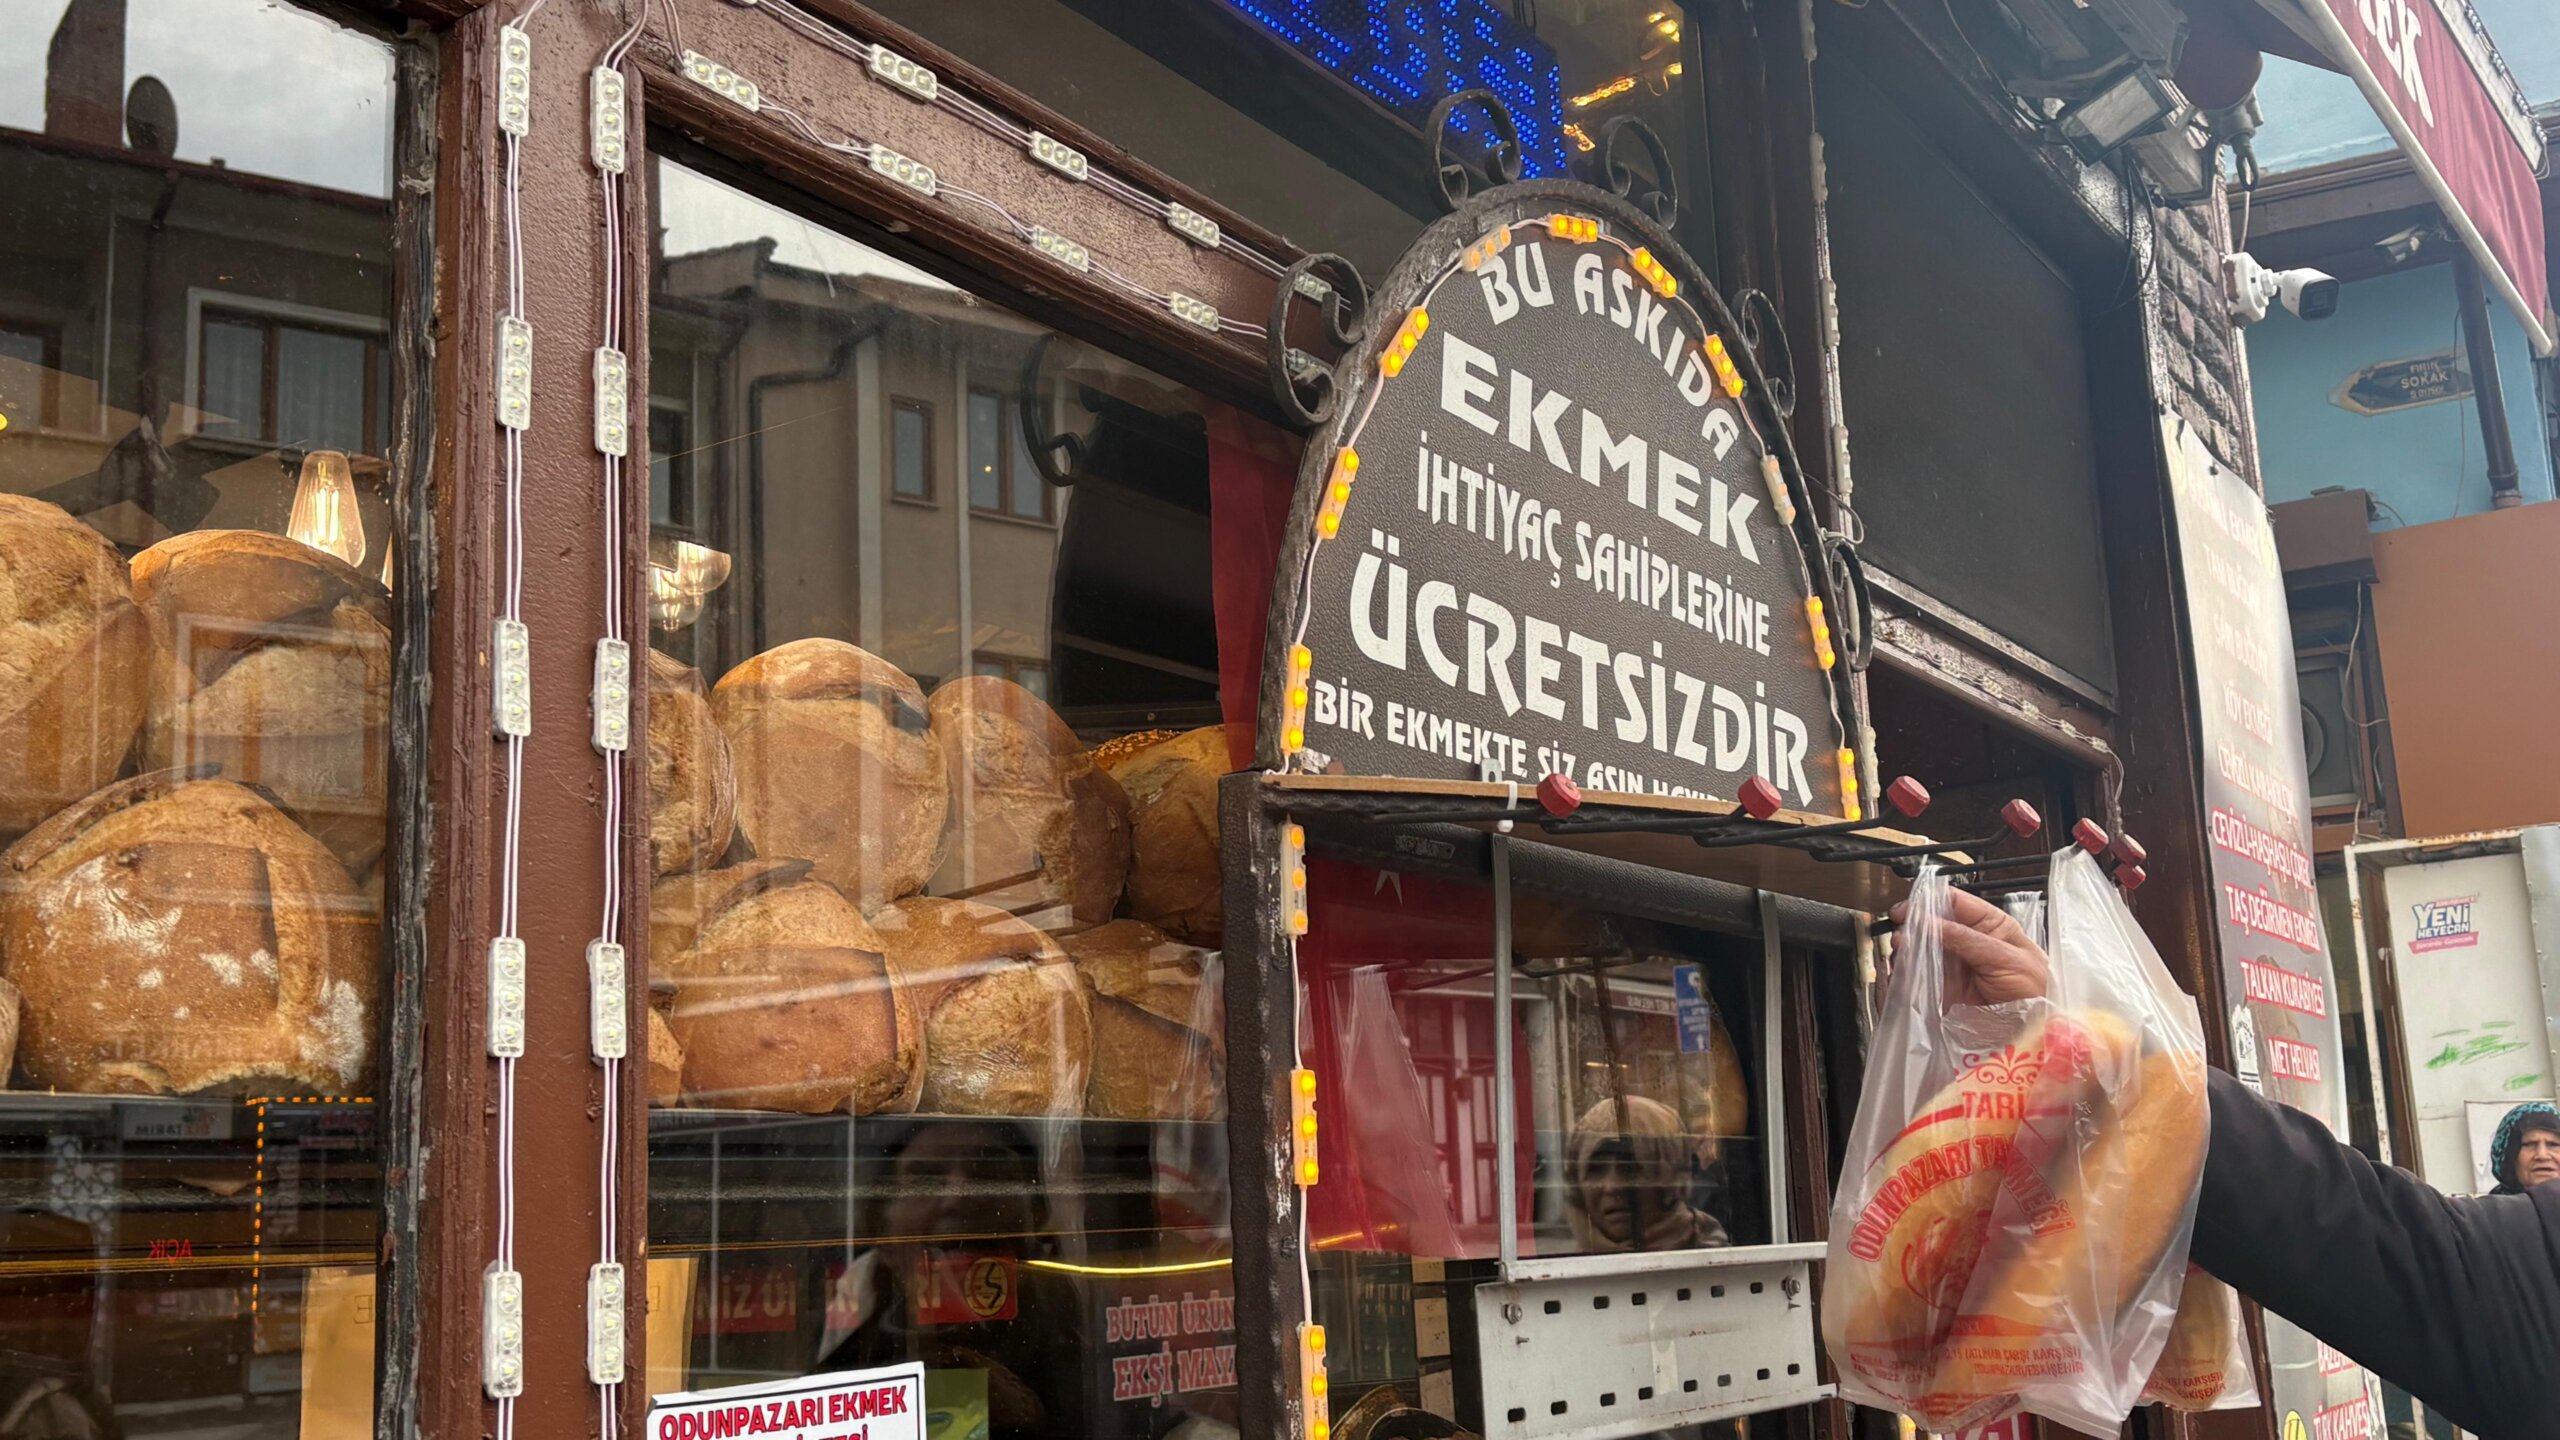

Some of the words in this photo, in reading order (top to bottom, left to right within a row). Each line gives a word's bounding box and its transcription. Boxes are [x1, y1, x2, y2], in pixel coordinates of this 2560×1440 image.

[1477, 242, 1555, 326] BU
[1572, 252, 1739, 462] ASKIDA
[2400, 370, 2449, 390] SOKAK
[1439, 330, 1762, 565] EKMEK
[1416, 430, 1564, 589] İHTİYAÇ
[1574, 520, 1772, 657] SAHİPLERİNE
[1348, 528, 1814, 808] ÜCRETSİZDİR
[1314, 677, 1376, 741] BİR
[1386, 701, 1528, 779] EKMEKTE
[2225, 886, 2249, 937] TAŞ
[2248, 885, 2295, 941] DEĞİRMEN
[2413, 903, 2470, 930] YENİ
[2418, 922, 2470, 939] HEYECAN
[2241, 962, 2281, 1005] TALKAN
[2280, 970, 2326, 1017] KURABİYESİ
[2268, 1038, 2290, 1074] MET
[2289, 1043, 2321, 1081] HELVASI
[1846, 1140, 1974, 1263] ODUNPAZARI
[1105, 1295, 1178, 1343] BÜTÜN
[1112, 1340, 1173, 1409] EKŞİ
[1176, 1344, 1239, 1393] MAY
[658, 1396, 823, 1440] ODUNPAZARI
[828, 1385, 908, 1423] EKMEK
[2333, 1400, 2370, 1440] KAHVES
